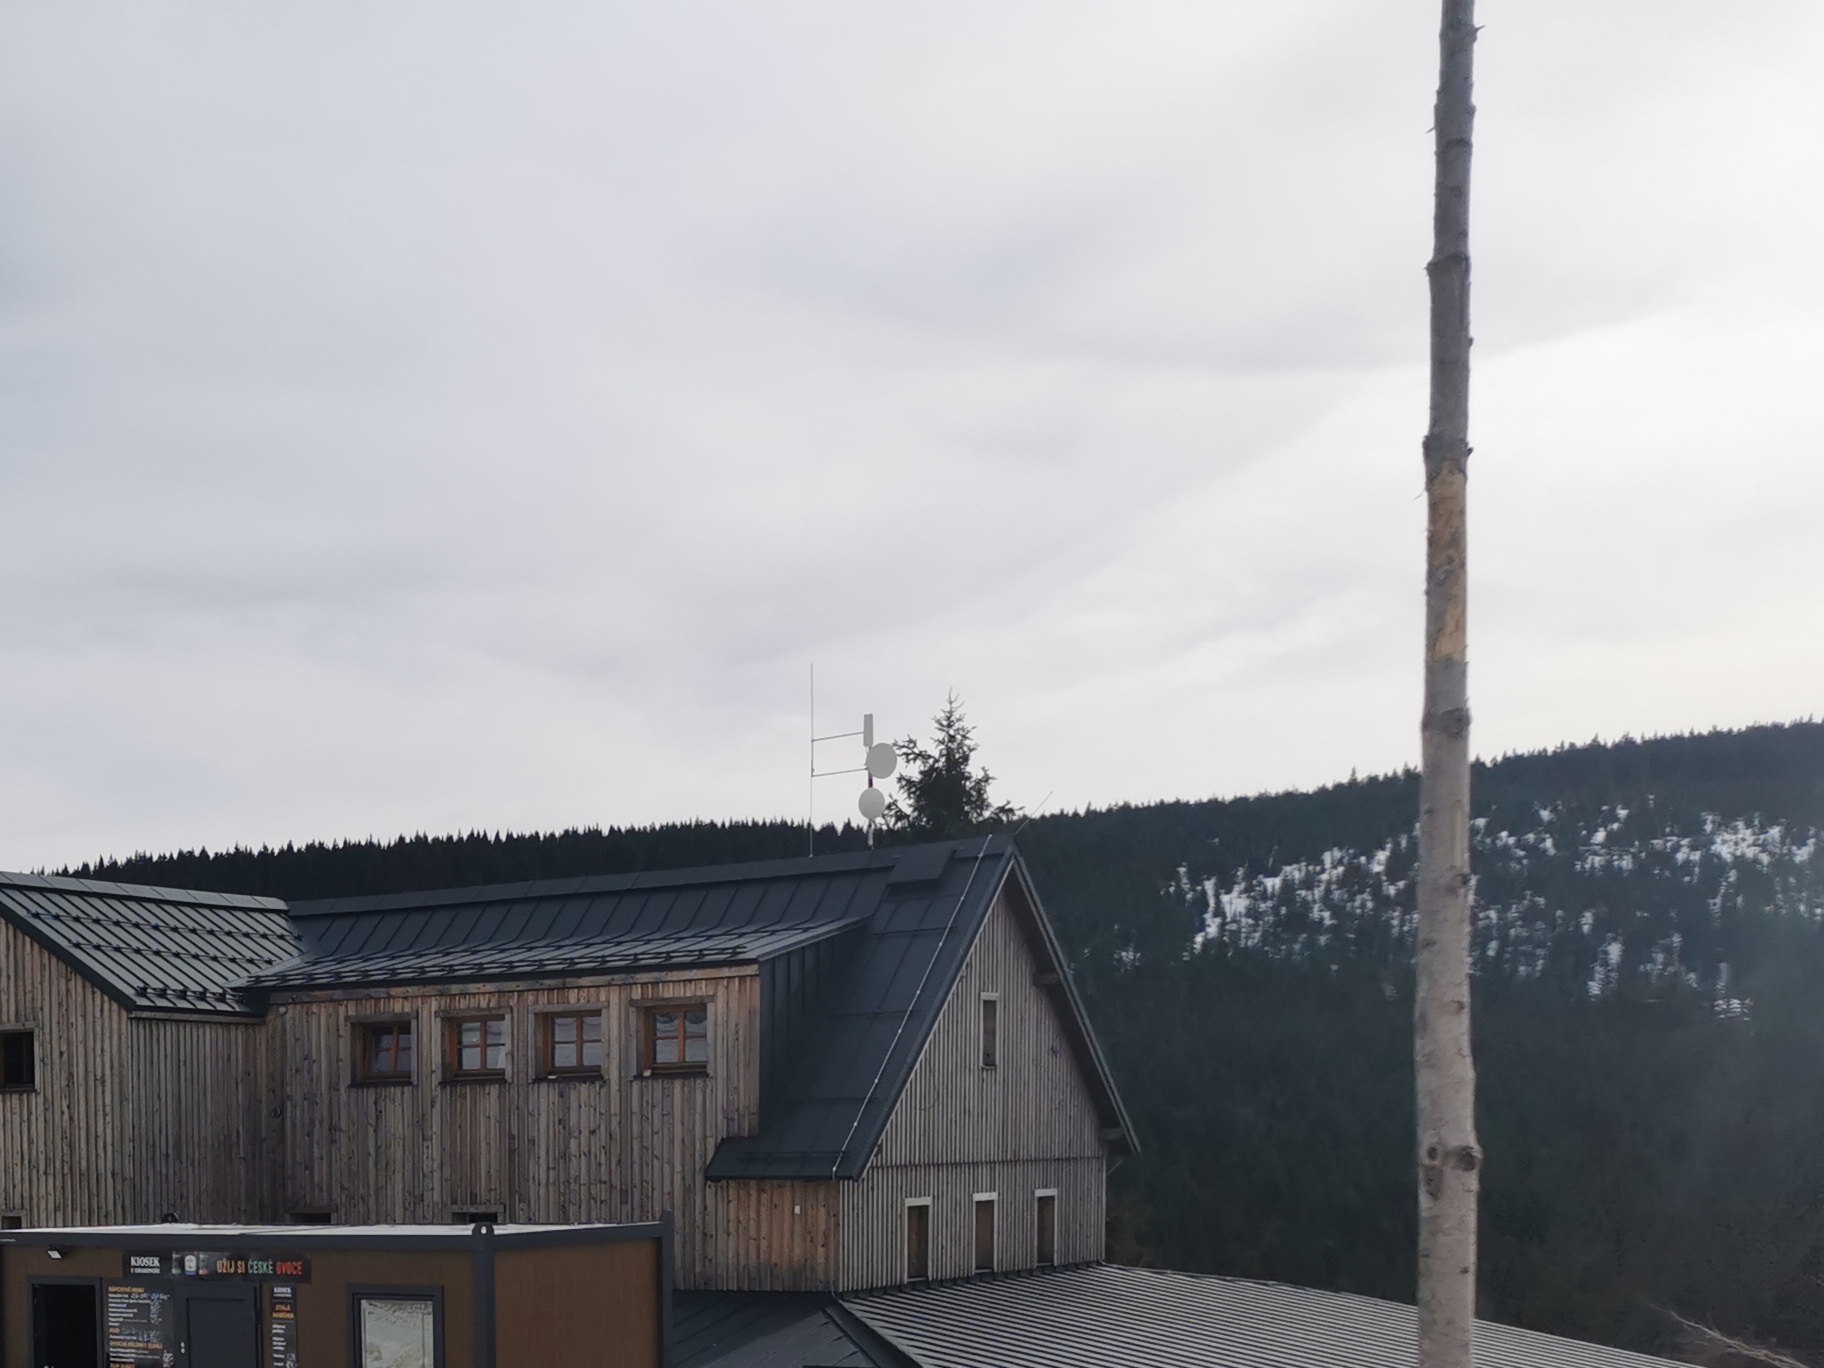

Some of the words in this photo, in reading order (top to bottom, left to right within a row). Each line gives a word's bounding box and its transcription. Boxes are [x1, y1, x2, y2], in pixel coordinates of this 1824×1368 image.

[130, 1256, 160, 1267] KIOSEK
[216, 1258, 235, 1274] UŽIJ
[237, 1260, 245, 1274] SI
[247, 1259, 274, 1274] ČESKÉ
[276, 1261, 303, 1275] OVOCE
